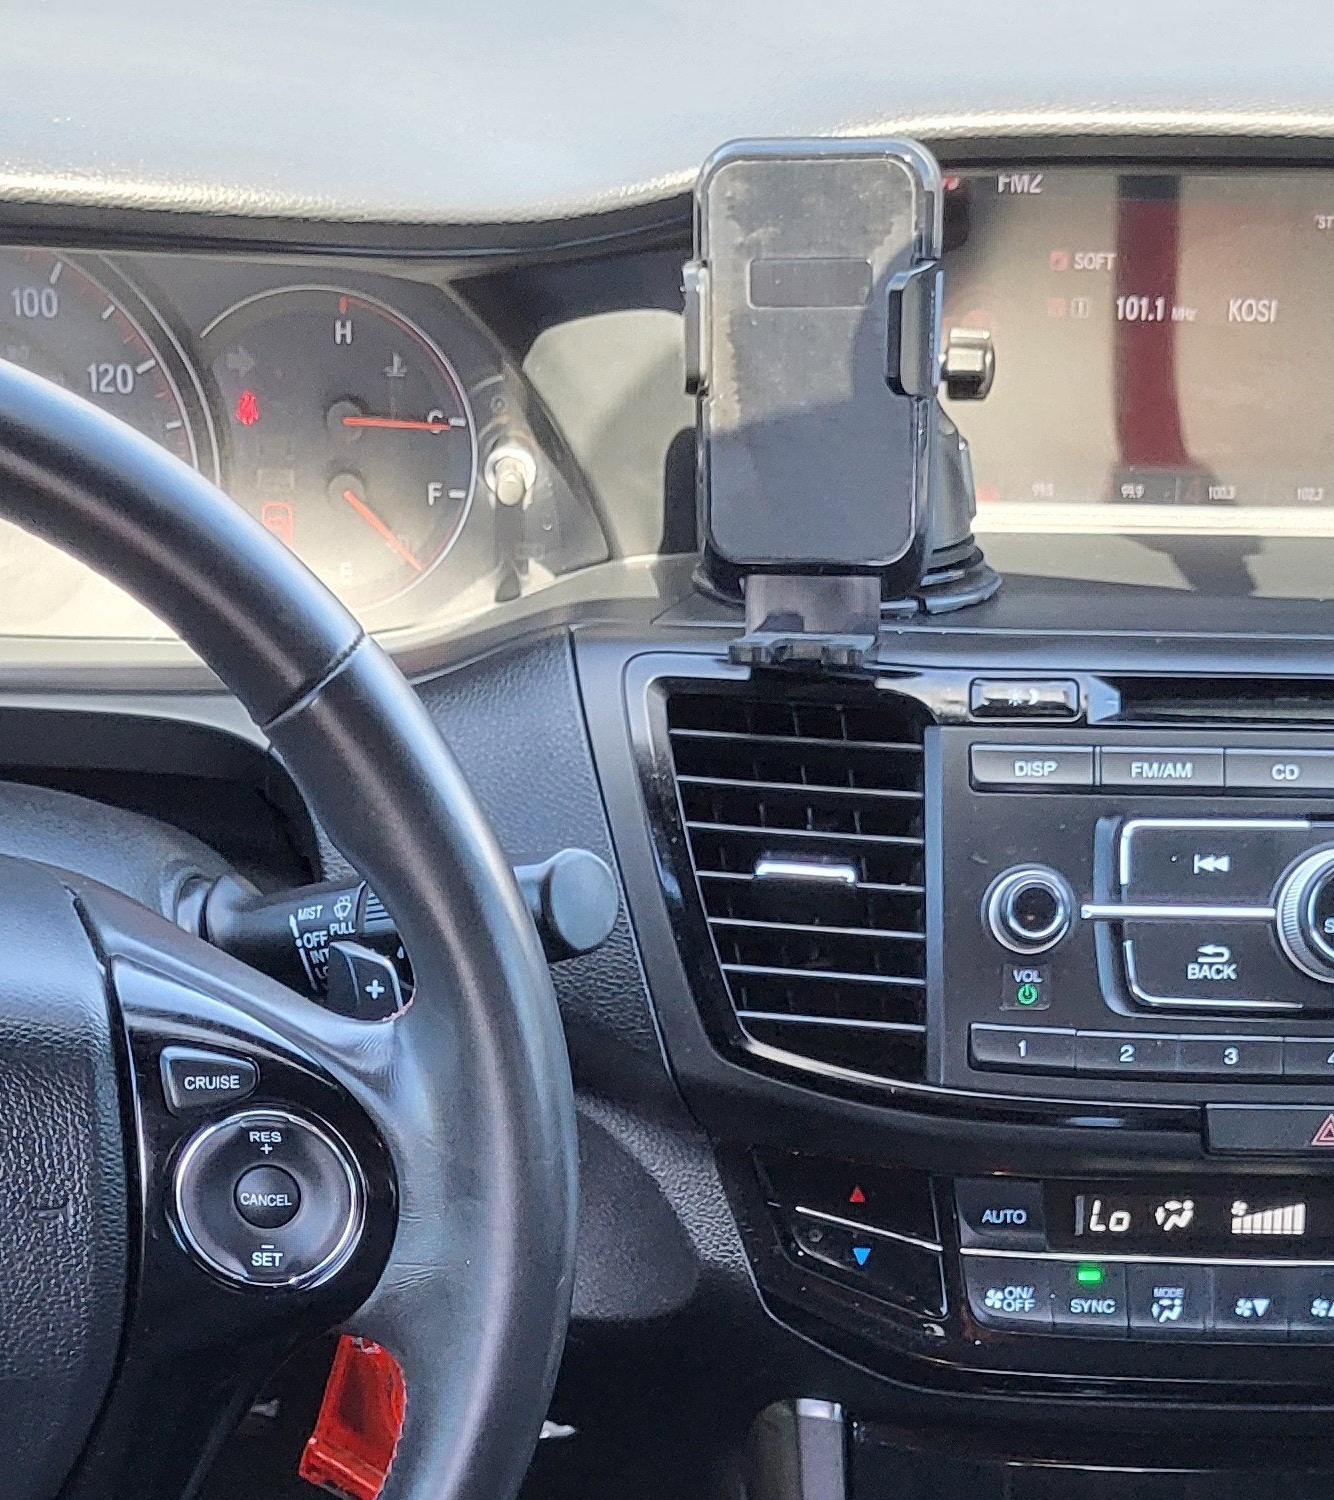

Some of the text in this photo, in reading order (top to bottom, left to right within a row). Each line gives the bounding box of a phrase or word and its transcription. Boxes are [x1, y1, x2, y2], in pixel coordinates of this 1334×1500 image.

[1073, 252, 1116, 271] SOFT
[10, 286, 58, 319] 100
[1116, 296, 1166, 322] 101.1
[1228, 298, 1278, 322] KOSI
[334, 319, 353, 345] H
[86, 361, 135, 395] 120
[427, 483, 443, 506] F
[1014, 761, 1058, 777] DISP
[1131, 762, 1193, 779] FM/AM
[1271, 764, 1300, 780] CD
[297, 904, 324, 921] MIST
[329, 921, 356, 937] PULL
[303, 930, 328, 949] OFF
[1012, 968, 1043, 983] VOL
[1187, 962, 1237, 980] BACK
[1018, 1039, 1027, 1057] 1
[1119, 1044, 1135, 1062] 2
[1223, 1046, 1240, 1065] 3
[183, 1075, 241, 1091] CRUISE
[249, 1131, 282, 1144] RES
[240, 1193, 293, 1207] CANCEL
[981, 1208, 1028, 1226] AUTO
[1088, 1199, 1132, 1233] Lo
[251, 1252, 283, 1267] SET
[1003, 1285, 1035, 1301] ON/
[1153, 1286, 1185, 1299] MODE
[1002, 1297, 1036, 1314] OFF
[1069, 1297, 1117, 1315] SYNC
